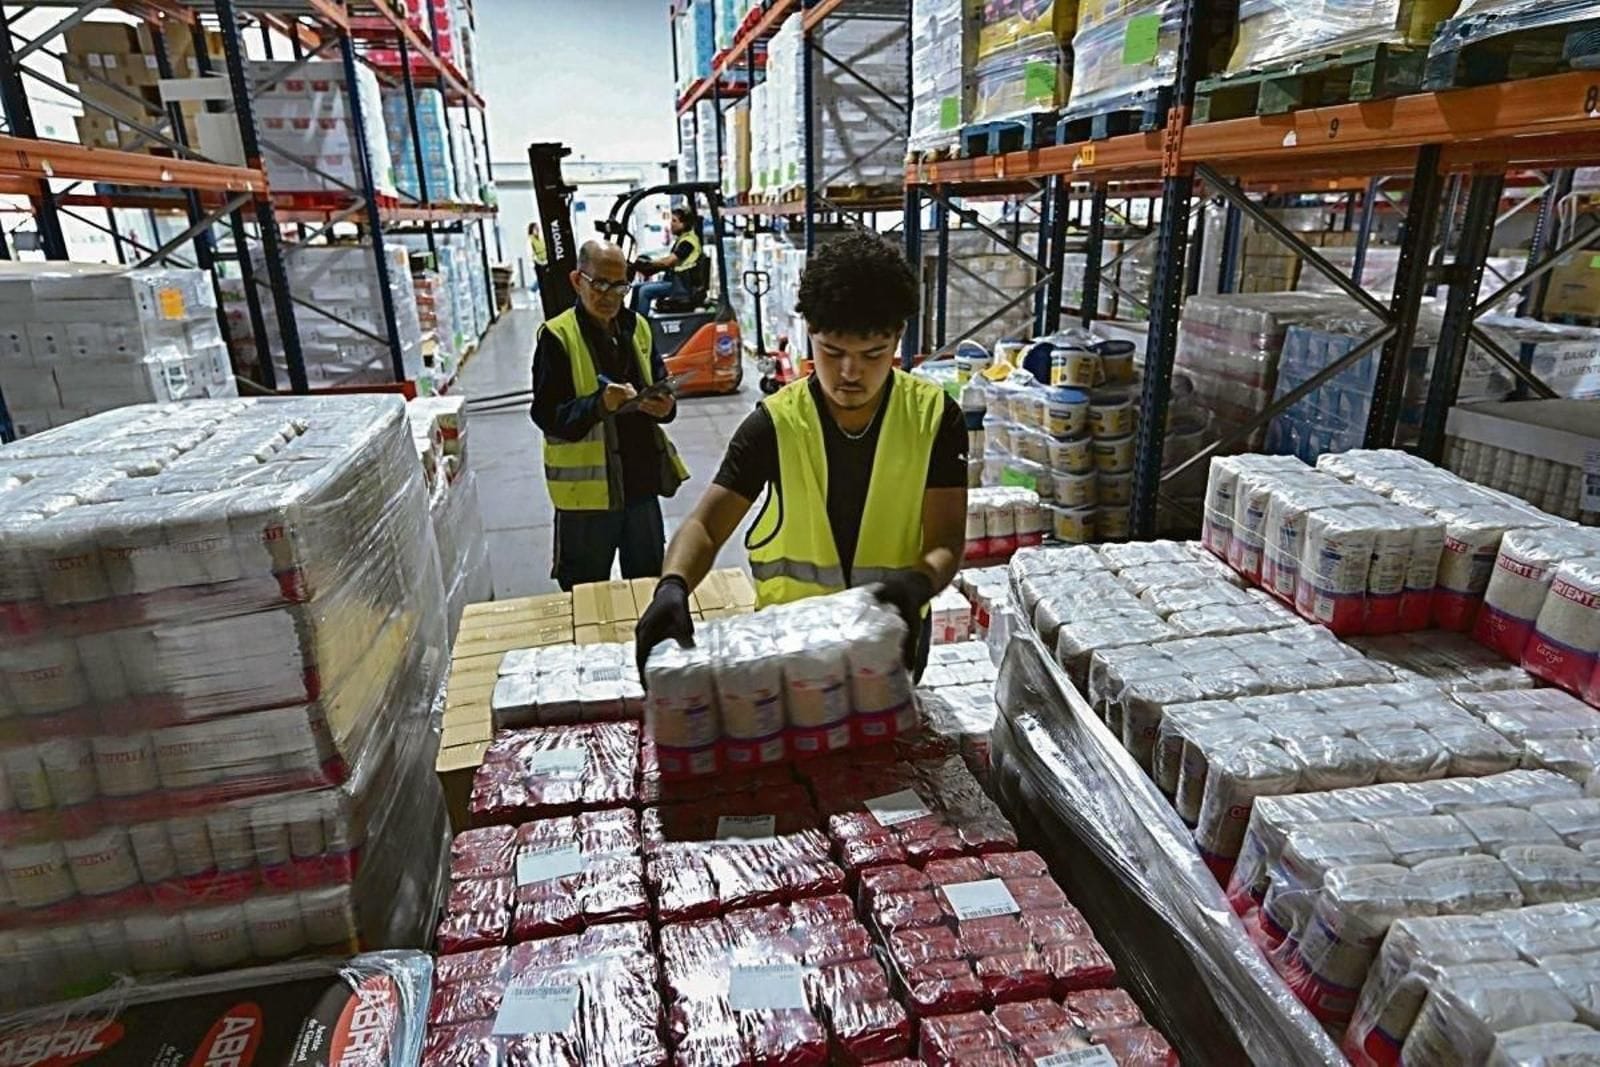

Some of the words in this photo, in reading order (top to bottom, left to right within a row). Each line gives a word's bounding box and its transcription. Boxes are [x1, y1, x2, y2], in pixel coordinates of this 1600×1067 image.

[1584, 85, 1599, 114] 8
[1328, 117, 1340, 139] 9
[550, 219, 565, 261] TOYOTA
